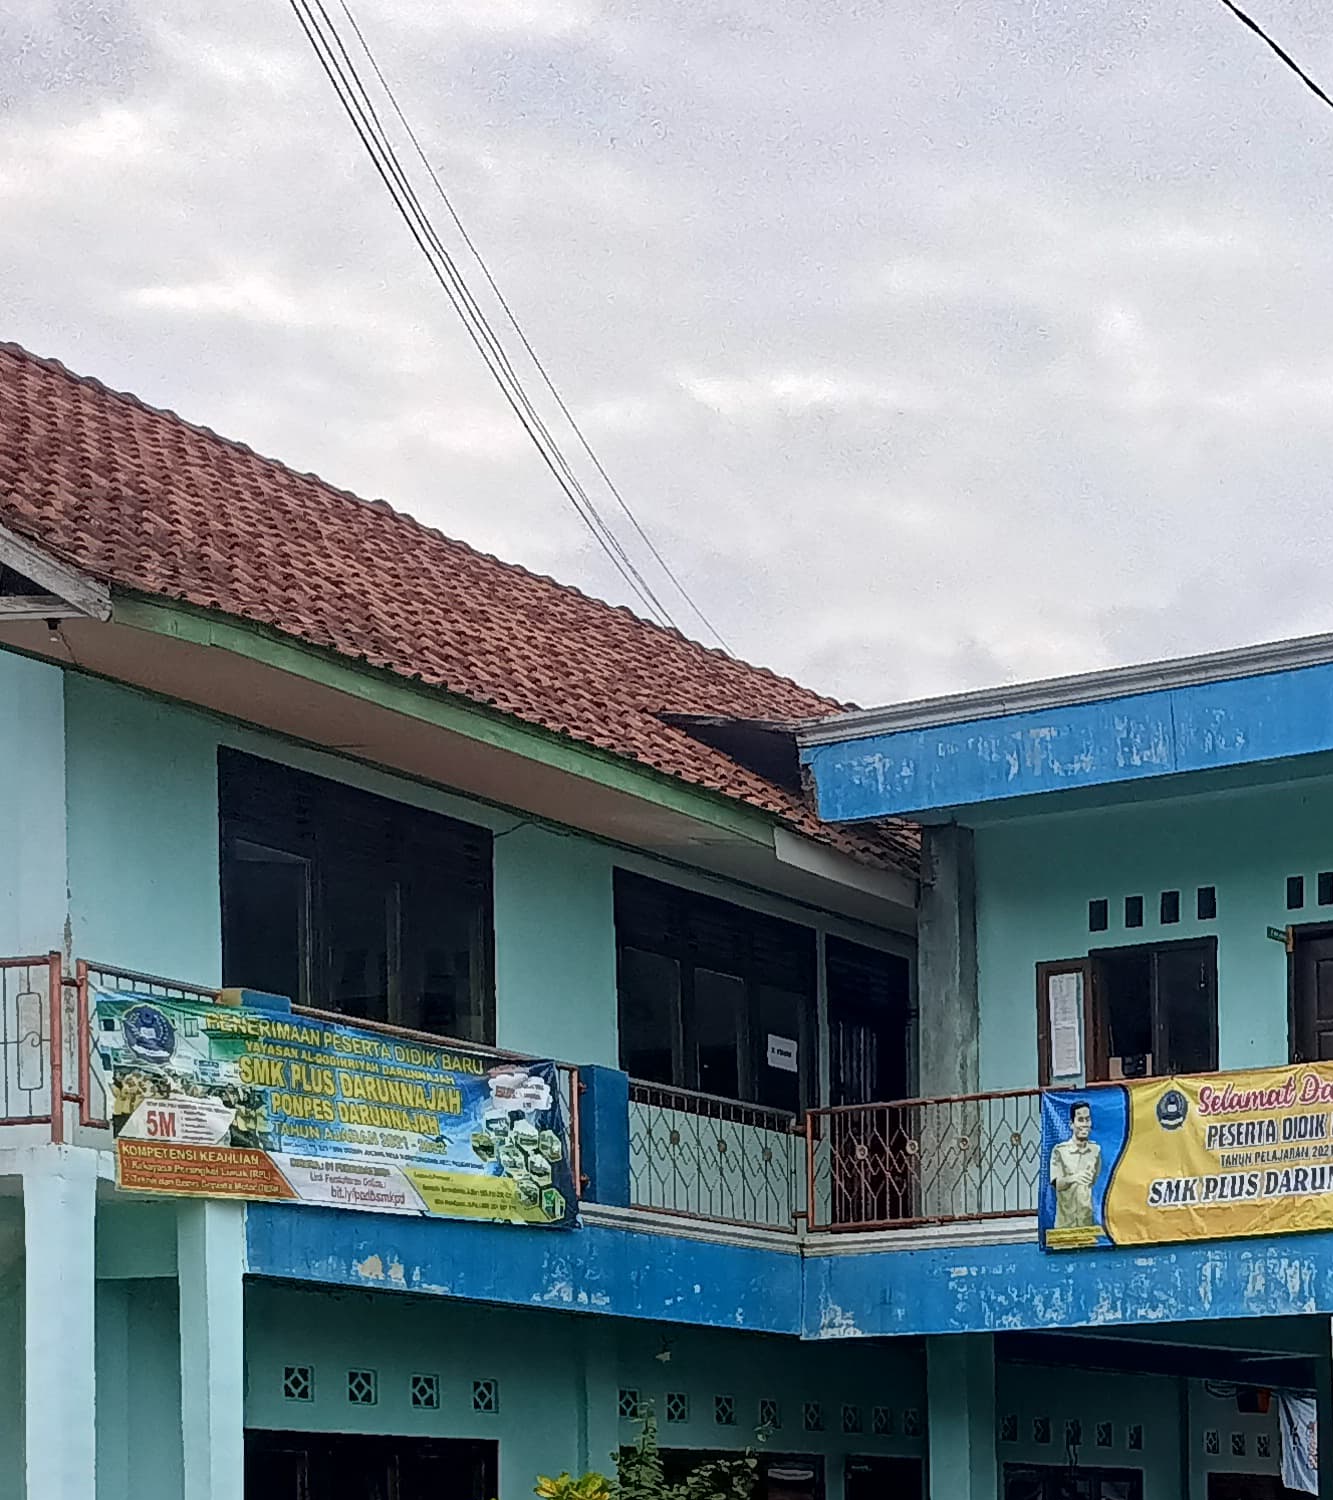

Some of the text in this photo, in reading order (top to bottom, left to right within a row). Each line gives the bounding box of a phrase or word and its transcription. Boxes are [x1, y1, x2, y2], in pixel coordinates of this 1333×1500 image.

[206, 1013, 484, 1075] PENERIMAAN PESERTA DIDIK BARU
[245, 1040, 298, 1059] YAYASAN
[239, 1056, 285, 1087] SMK
[291, 1064, 335, 1095] PLUS
[341, 1071, 461, 1115] DARUNNAJAH
[1199, 1076, 1296, 1116] Selamat
[146, 1110, 177, 1137] 5M
[271, 1091, 440, 1135] PONPES DARUNNAJAH
[273, 1122, 320, 1140] TAHUN
[1207, 1118, 1278, 1149] PESERTA
[1282, 1114, 1326, 1142] DIDIK
[122, 1144, 260, 1165] KOMPETENSI KEAHLIAN
[1220, 1152, 1253, 1168] TAHUN
[1254, 1147, 1309, 1163] PELAJARAN
[1149, 1179, 1198, 1207] SMK
[1204, 1172, 1260, 1200] PLUS
